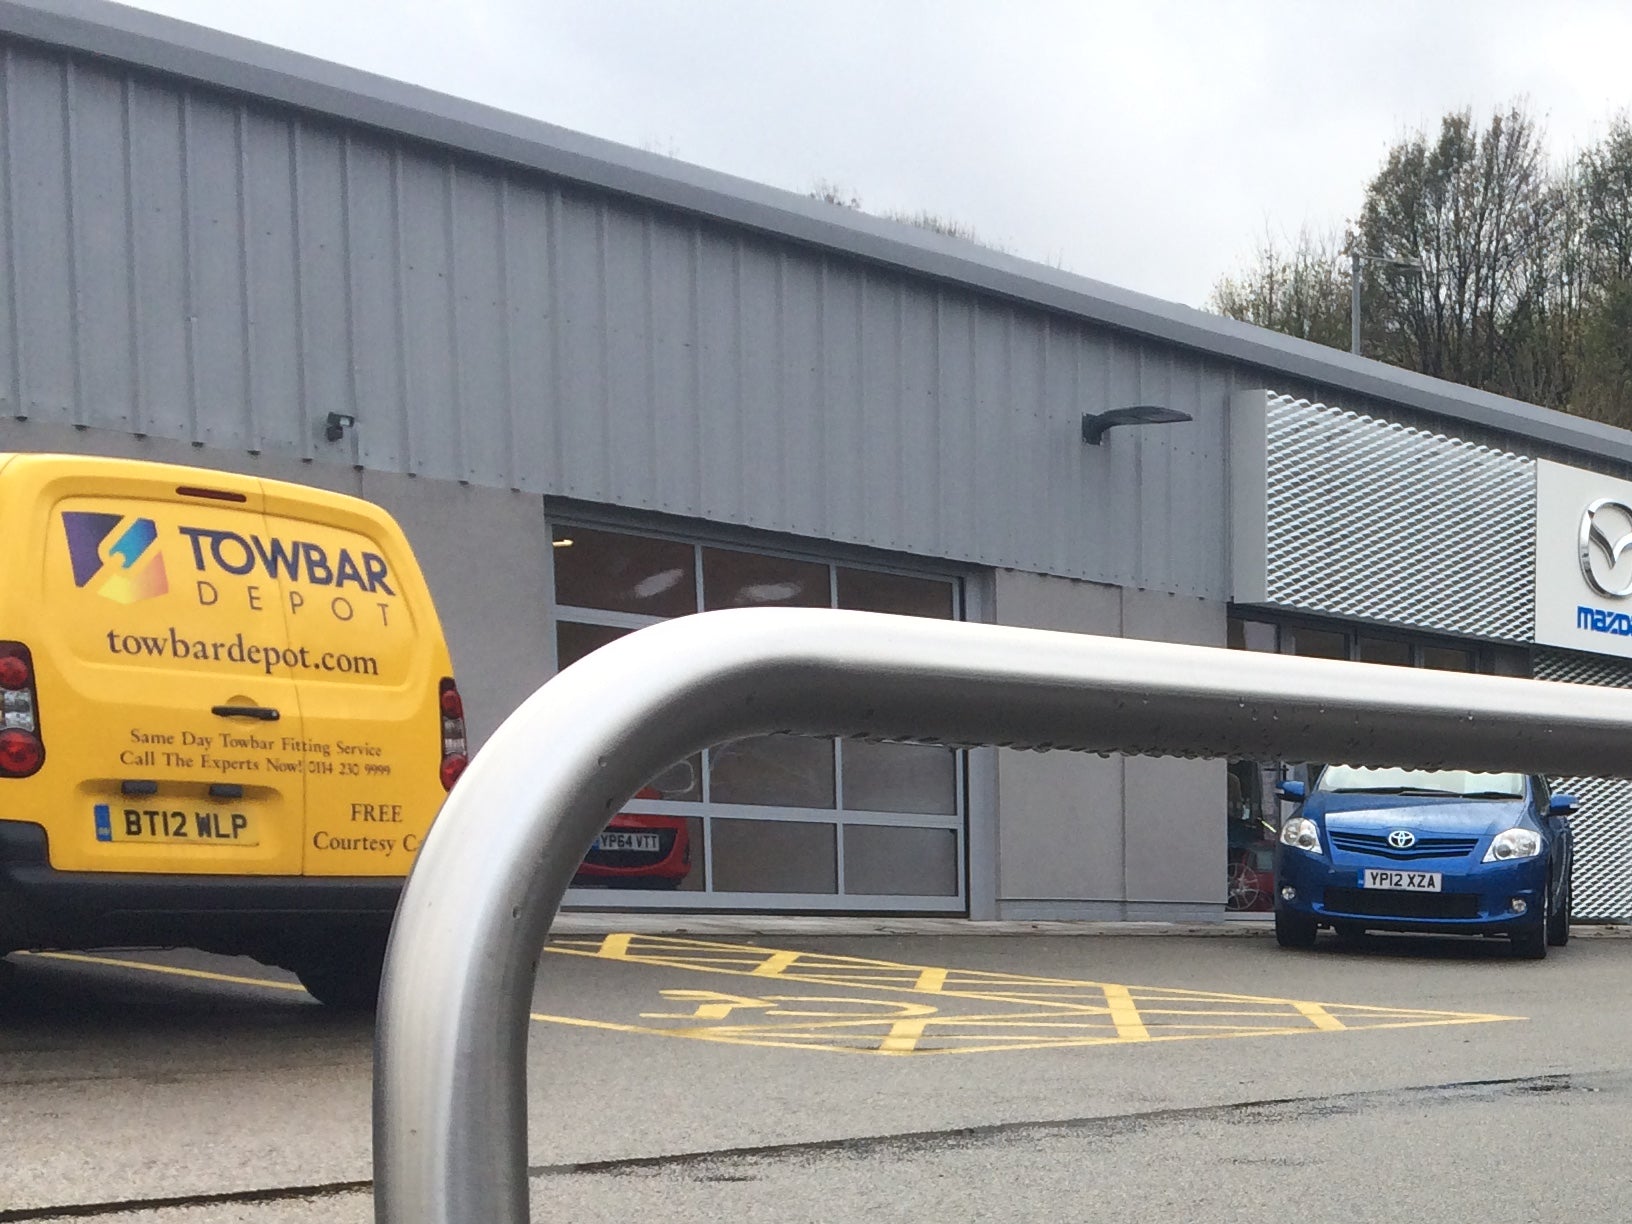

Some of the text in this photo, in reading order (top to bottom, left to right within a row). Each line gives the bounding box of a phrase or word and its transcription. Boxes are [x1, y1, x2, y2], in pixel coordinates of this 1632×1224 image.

[178, 526, 396, 596] TOWBAR
[197, 581, 389, 626] DEPOT
[107, 627, 379, 675] towbardepot.com
[131, 729, 382, 757] Same Day Towbar Fitting Service
[120, 751, 155, 766] Call
[163, 753, 194, 768] The
[201, 754, 259, 773] Experts
[266, 758, 303, 773] Now!
[124, 809, 247, 839] BT12 WLP
[350, 803, 403, 822] FREE
[313, 831, 396, 857] Courtesy
[600, 834, 657, 848] YP64 VTT
[1371, 871, 1435, 888] YP12 XZA
